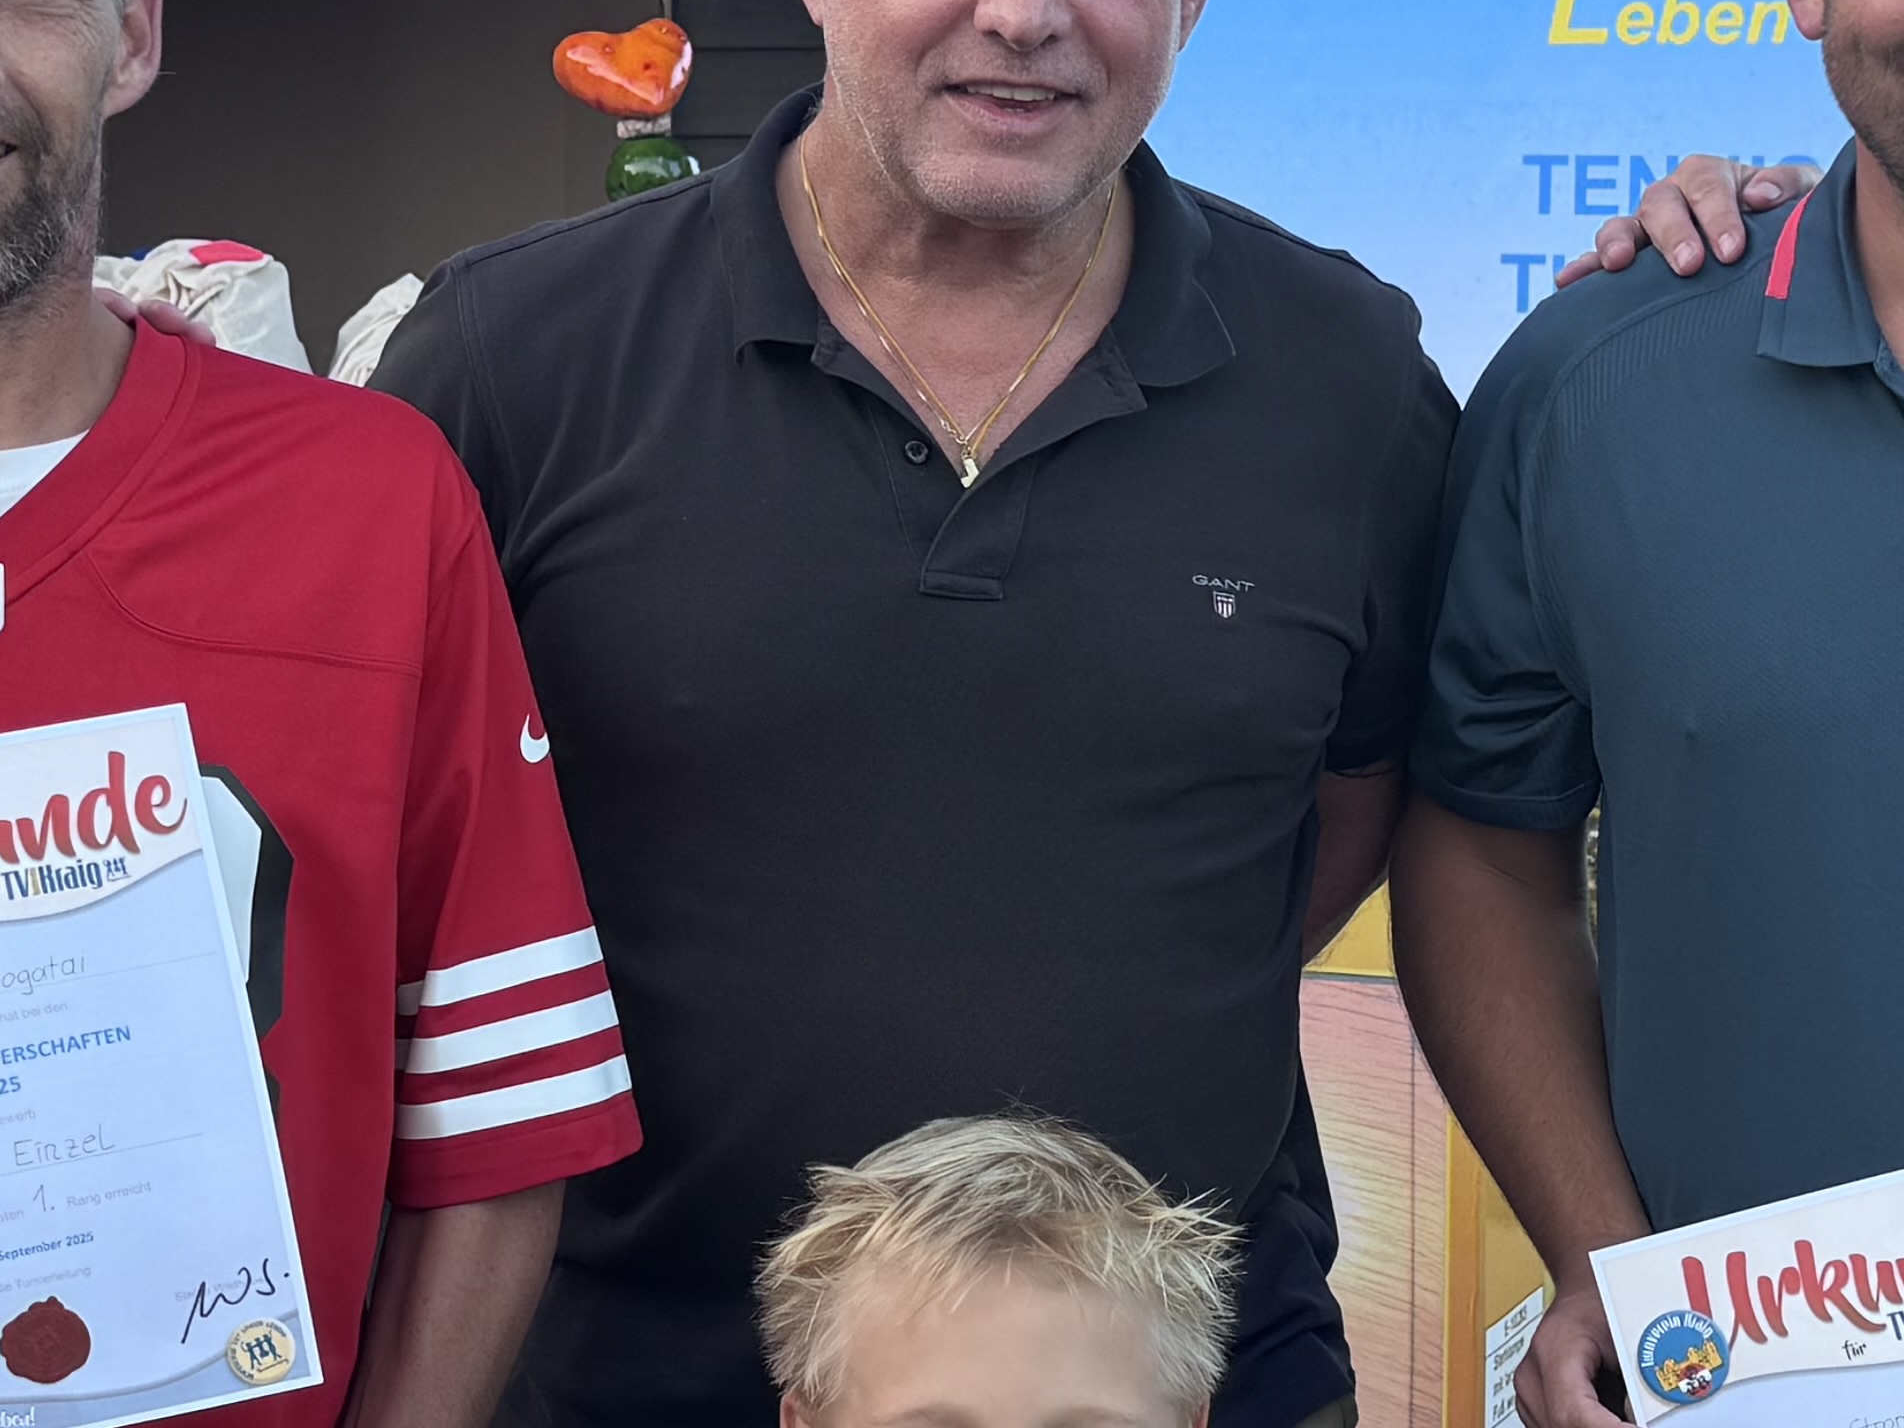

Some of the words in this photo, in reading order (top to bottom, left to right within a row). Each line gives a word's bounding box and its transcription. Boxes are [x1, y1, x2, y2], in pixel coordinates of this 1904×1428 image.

[1192, 574, 1255, 592] GANT
[43, 1002, 69, 1015] den
[13, 1123, 116, 1167] Einzel
[66, 1193, 101, 1209] Rang
[65, 1231, 94, 1248] 2025
[1842, 1340, 1867, 1361] für
